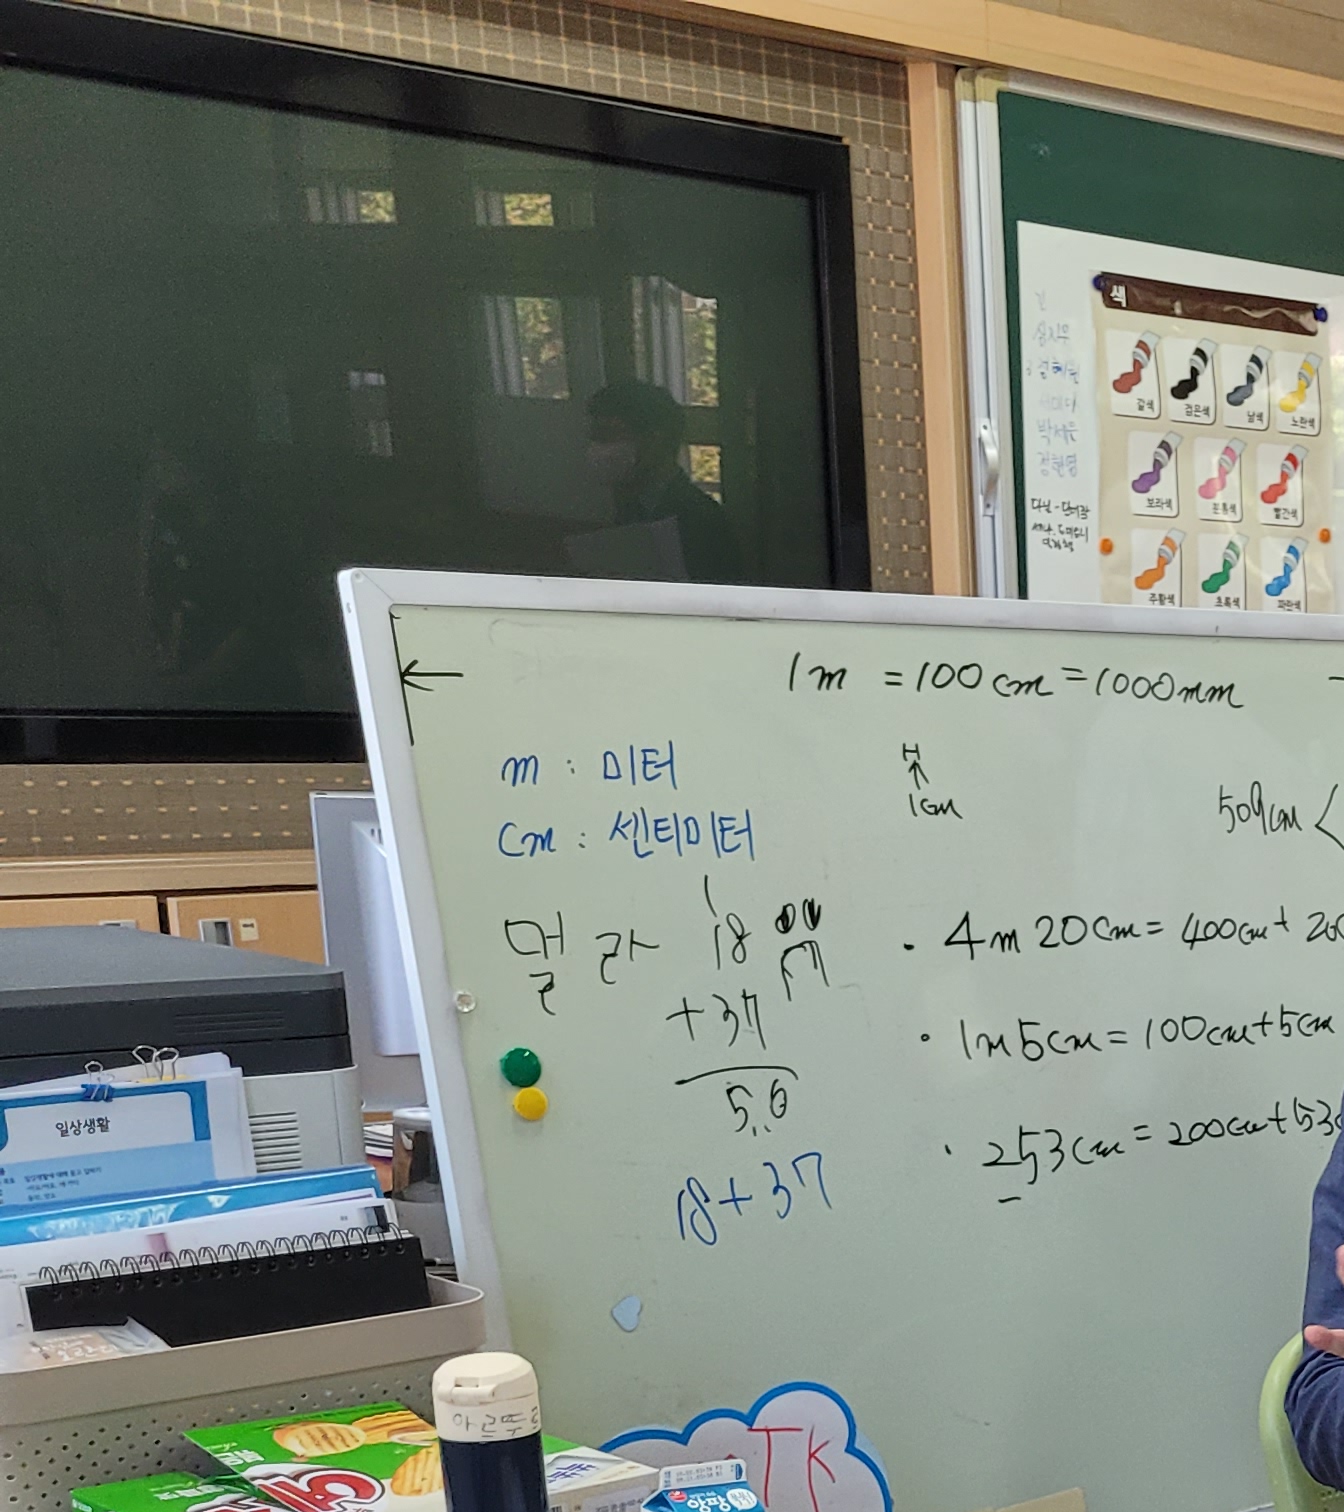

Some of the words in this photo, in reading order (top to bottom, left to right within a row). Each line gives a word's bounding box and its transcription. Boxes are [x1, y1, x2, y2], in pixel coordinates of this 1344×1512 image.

[1110, 285, 1128, 307] 색
[1148, 594, 1176, 606] 주황색
[500, 754, 539, 788] m
[603, 740, 678, 791] 미터
[608, 806, 756, 862] 센티미터
[55, 1116, 111, 1138] 일상생활
